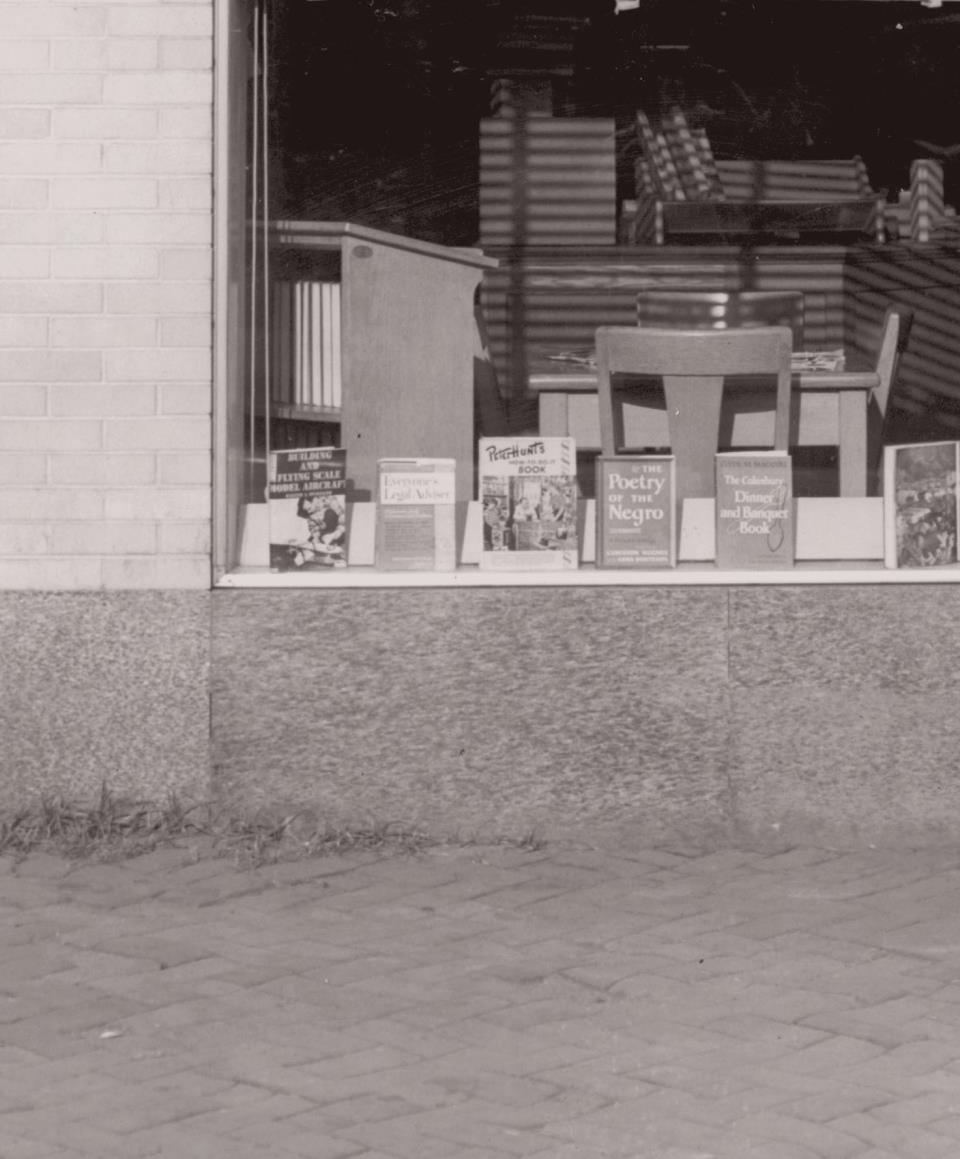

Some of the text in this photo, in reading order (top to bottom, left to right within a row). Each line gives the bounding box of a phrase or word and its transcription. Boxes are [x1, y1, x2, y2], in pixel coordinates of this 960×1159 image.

[287, 451, 333, 462] BUILDING
[300, 461, 320, 471] AND
[518, 465, 546, 474] BOOK
[642, 464, 663, 473] THE
[277, 470, 341, 483] FLYING SCALE
[723, 474, 740, 485] The
[608, 473, 667, 496] Poetry
[608, 494, 654, 504] OF THE
[735, 490, 775, 504] Dinner
[608, 503, 665, 527] Negro
[719, 505, 789, 523] and Banquet
[740, 520, 771, 535] Book
